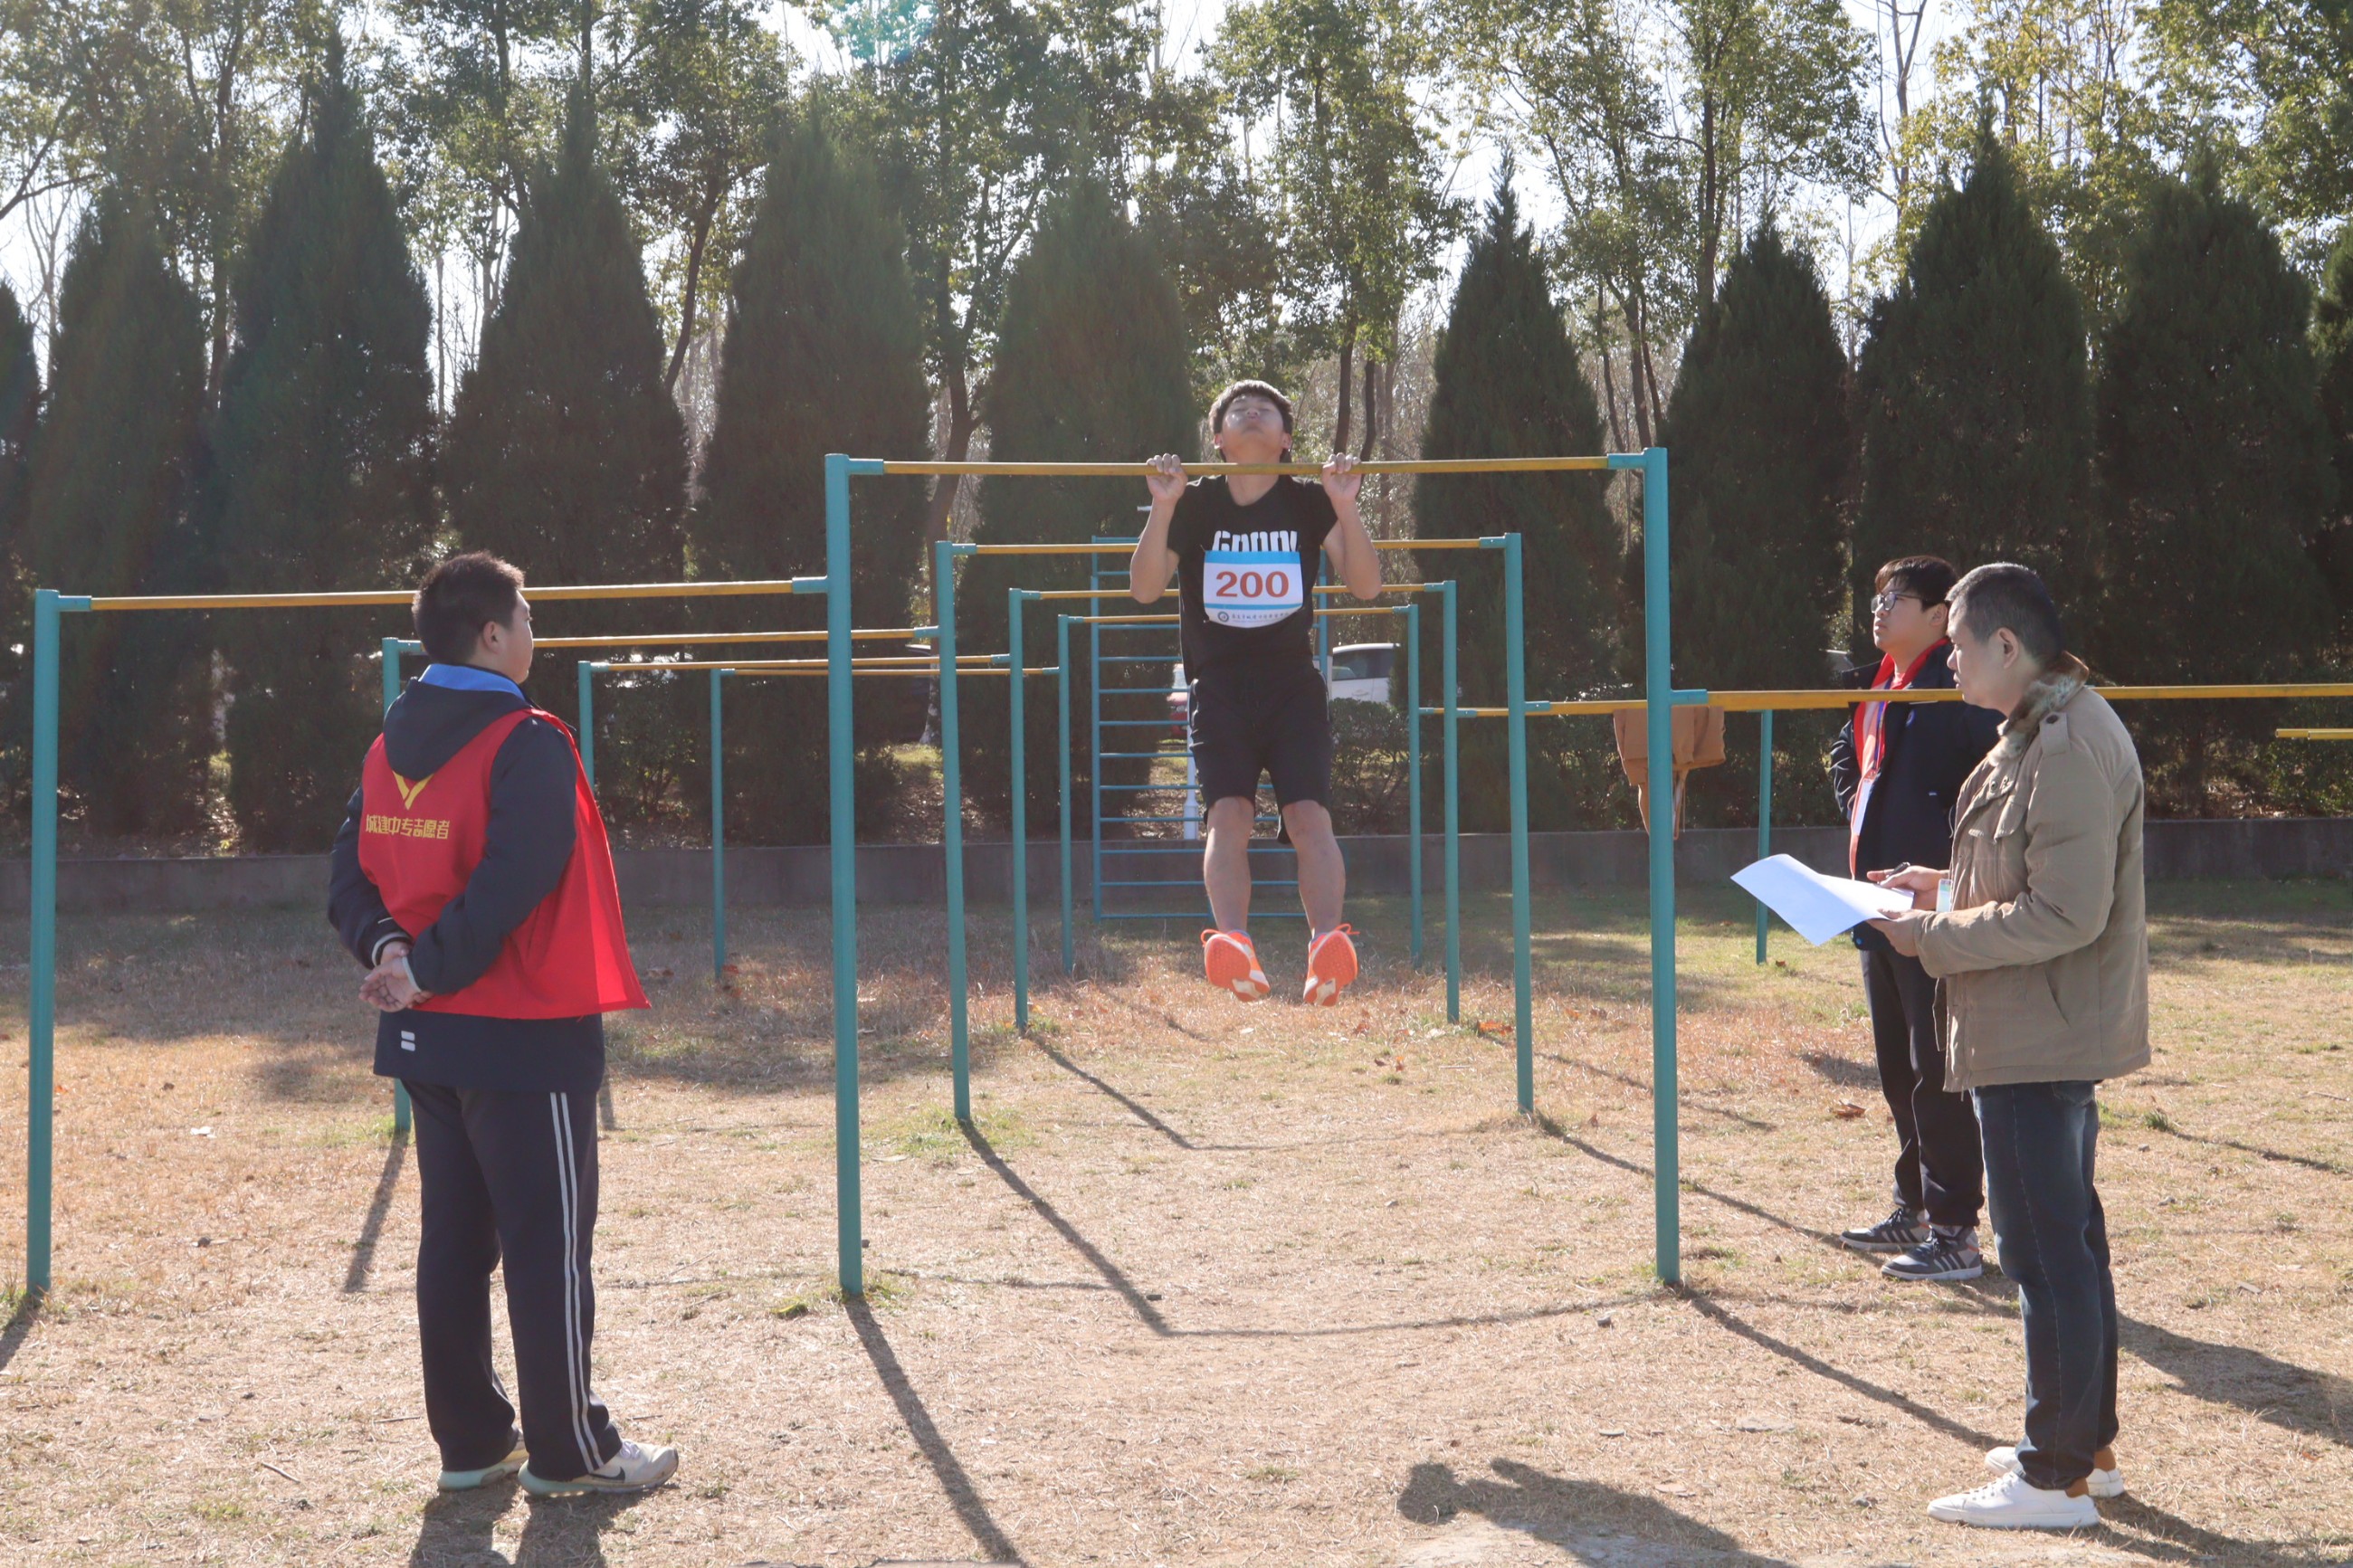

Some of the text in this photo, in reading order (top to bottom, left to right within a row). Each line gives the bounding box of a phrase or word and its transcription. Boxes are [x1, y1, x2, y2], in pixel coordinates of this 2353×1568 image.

[1215, 570, 1290, 598] 200
[366, 813, 451, 840] 城建中专志愿者
